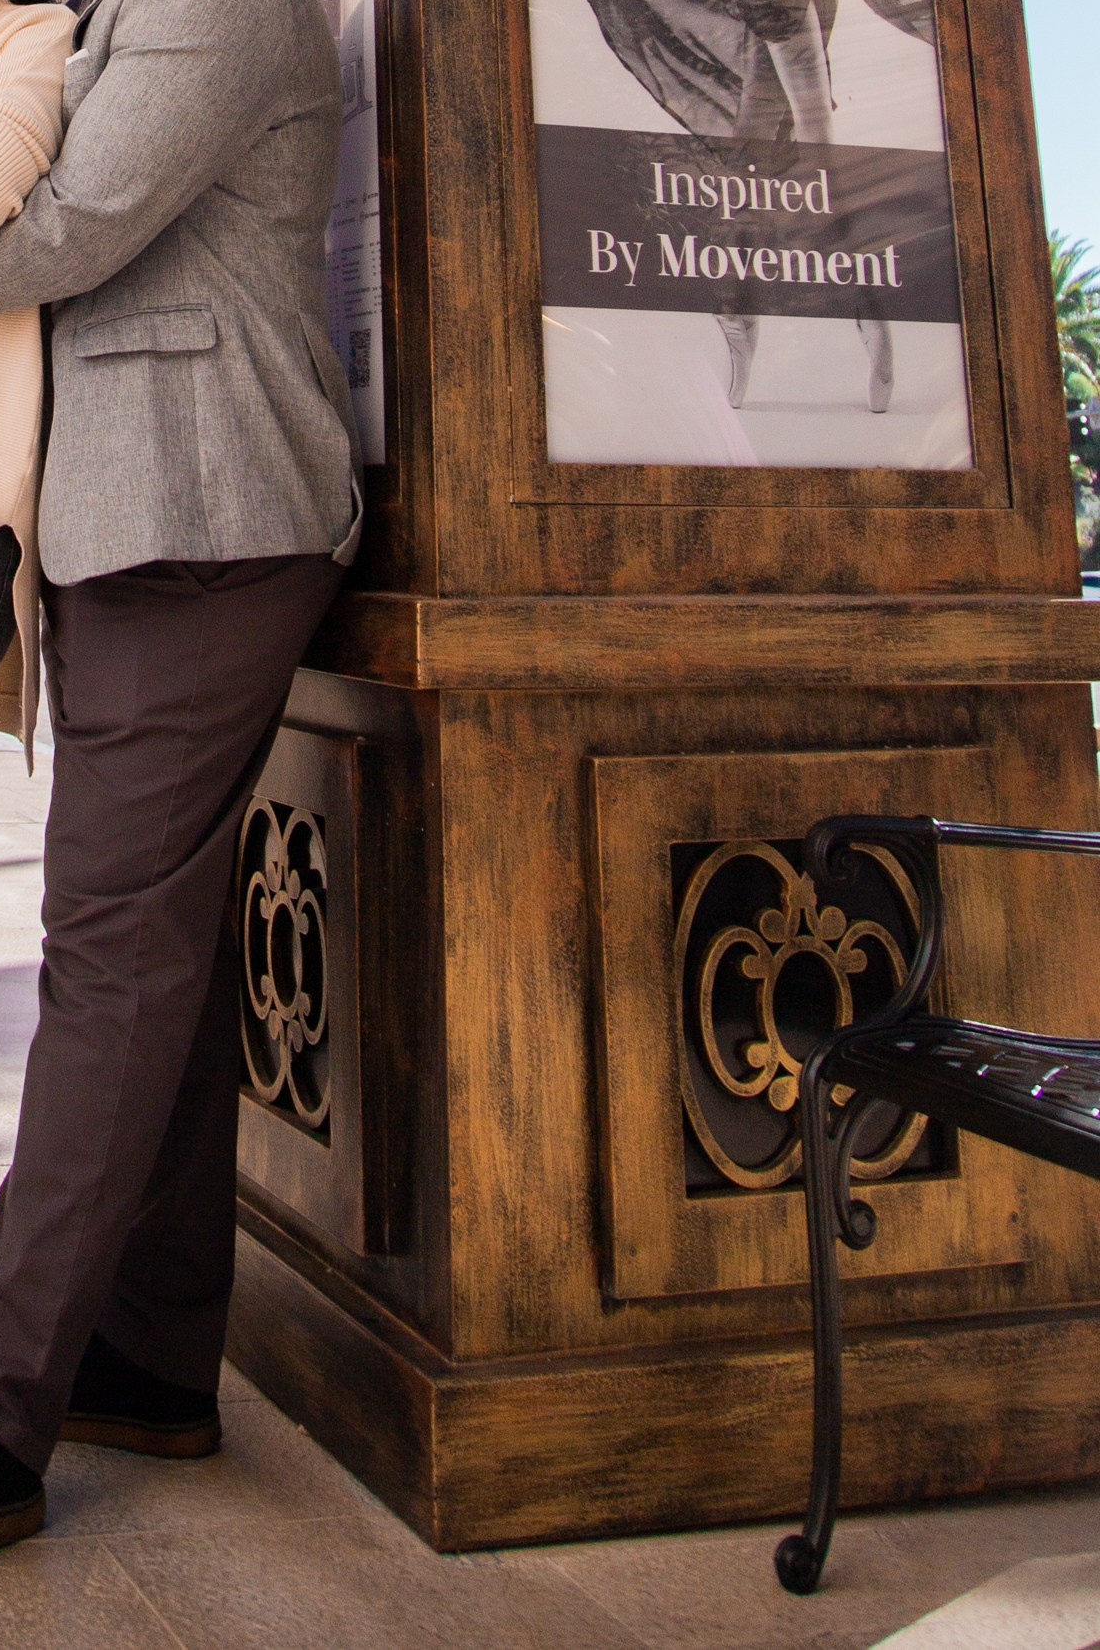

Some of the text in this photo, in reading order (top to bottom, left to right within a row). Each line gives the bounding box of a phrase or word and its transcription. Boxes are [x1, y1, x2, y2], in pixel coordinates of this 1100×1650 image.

[650, 162, 834, 220] Inspired
[587, 229, 903, 288] By Movement
